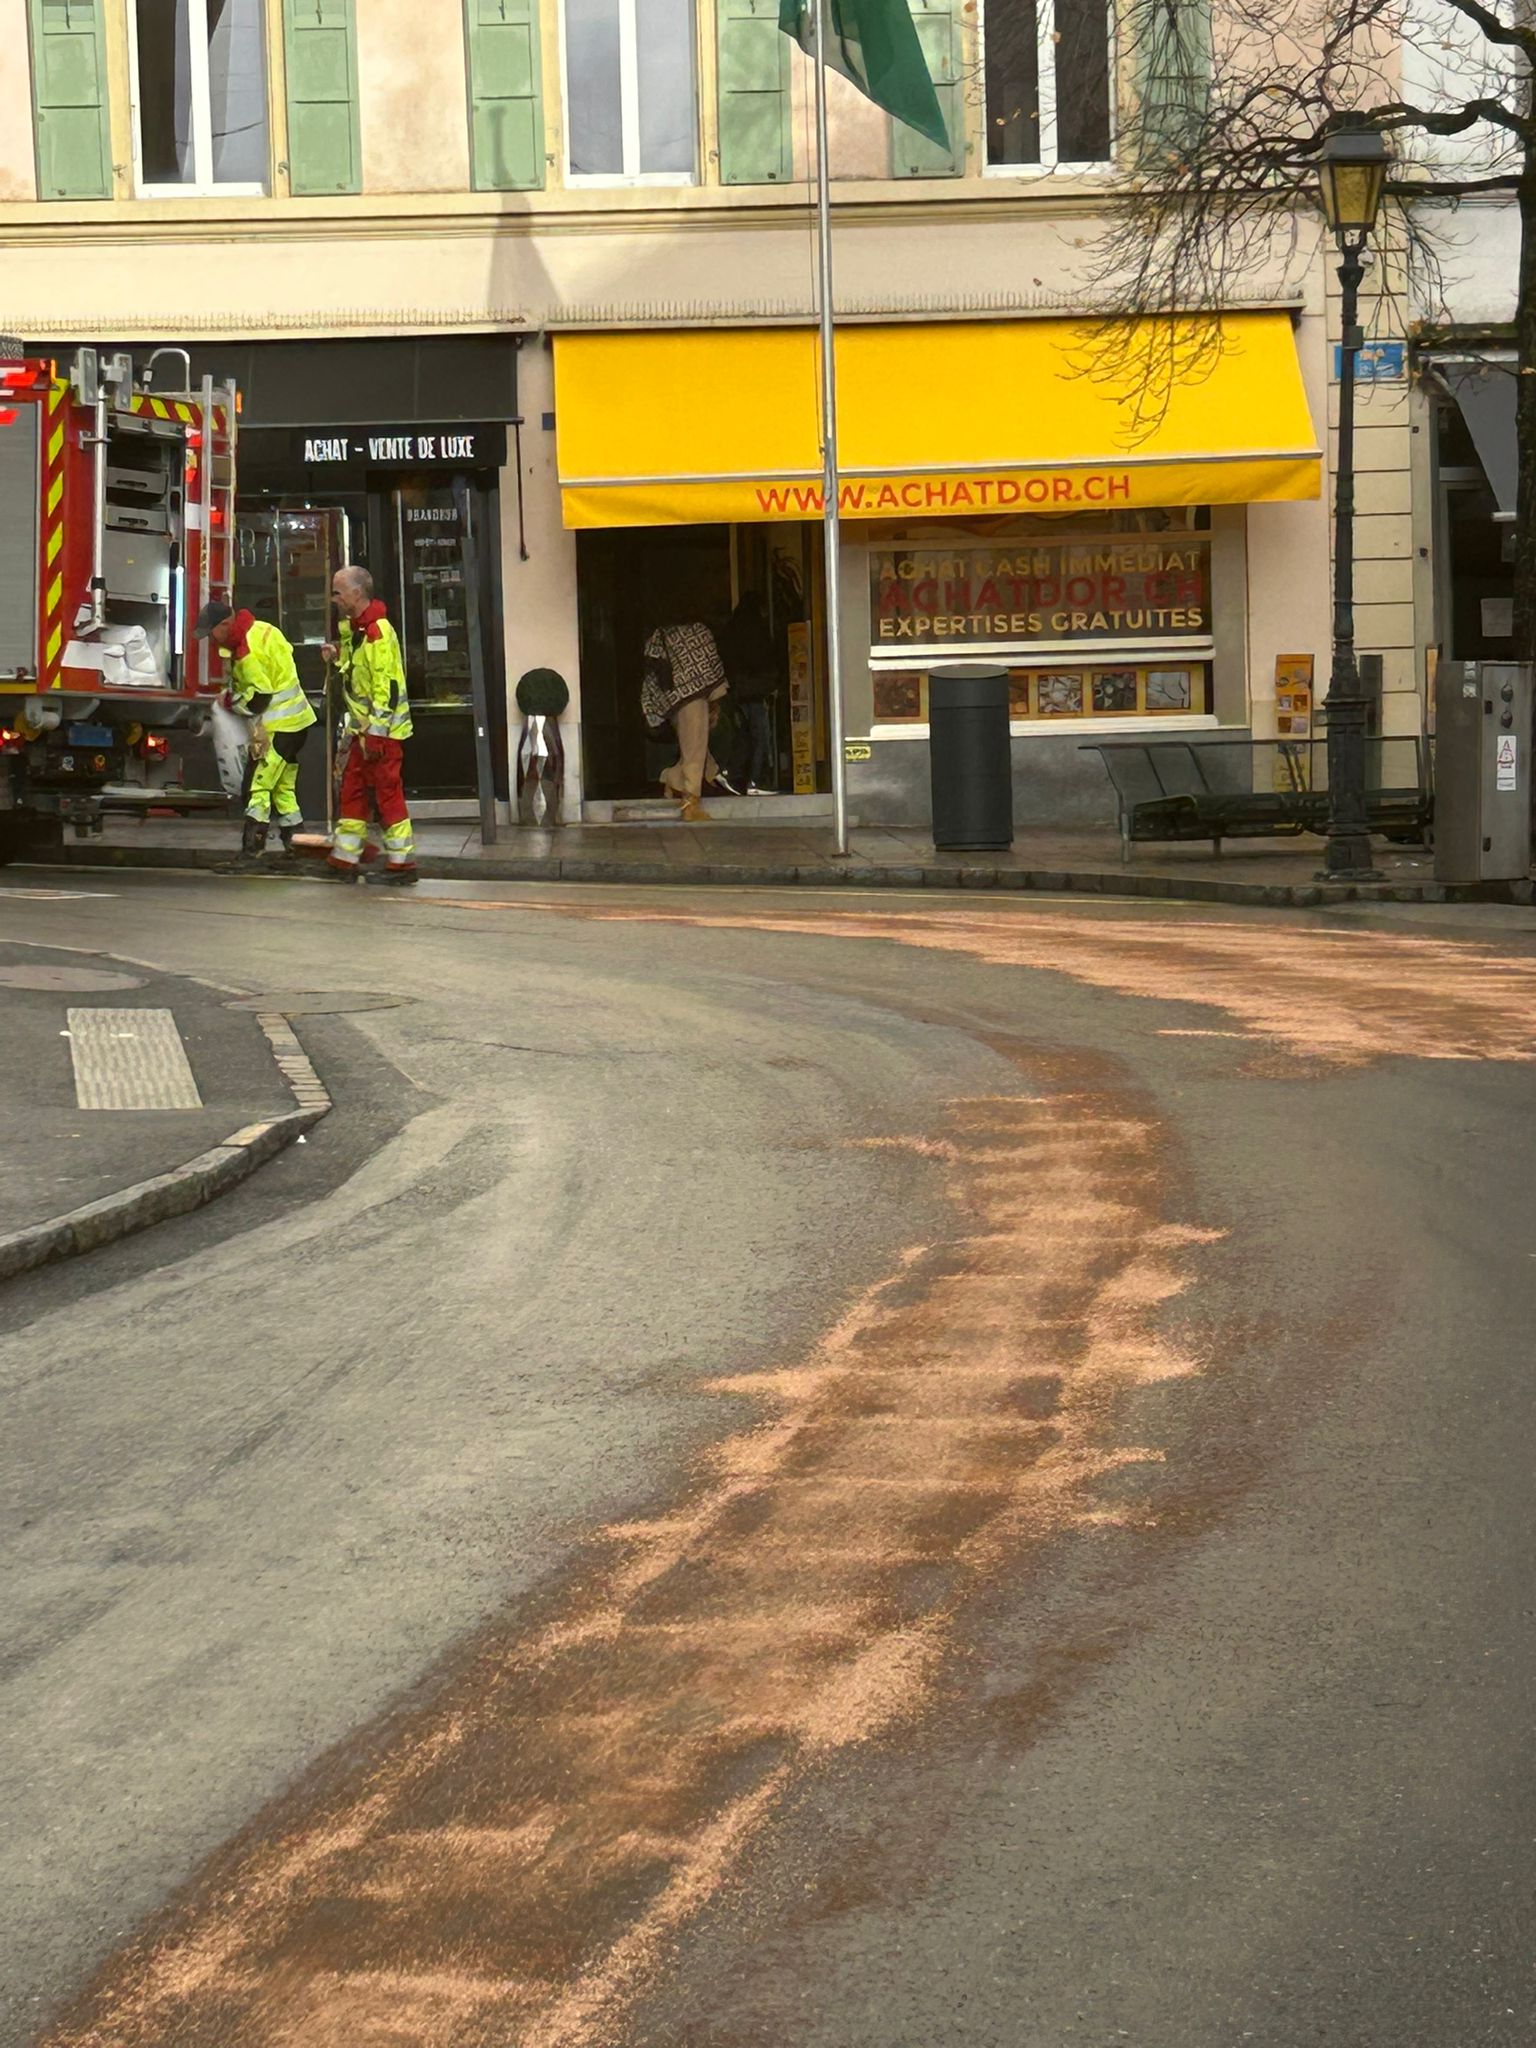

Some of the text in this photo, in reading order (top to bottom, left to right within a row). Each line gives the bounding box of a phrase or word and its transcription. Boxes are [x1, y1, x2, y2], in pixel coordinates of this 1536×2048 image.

[304, 438, 349, 462] ACHAT
[368, 437, 414, 460] VENTE
[417, 436, 436, 459] DE
[440, 436, 475, 459] LUXE
[755, 474, 1130, 513] WWW.ACHATDOR.CH
[879, 558, 966, 581] ACHAT
[974, 555, 1050, 577] CASH
[879, 607, 1204, 638] EXPERTISES GRATUITES
